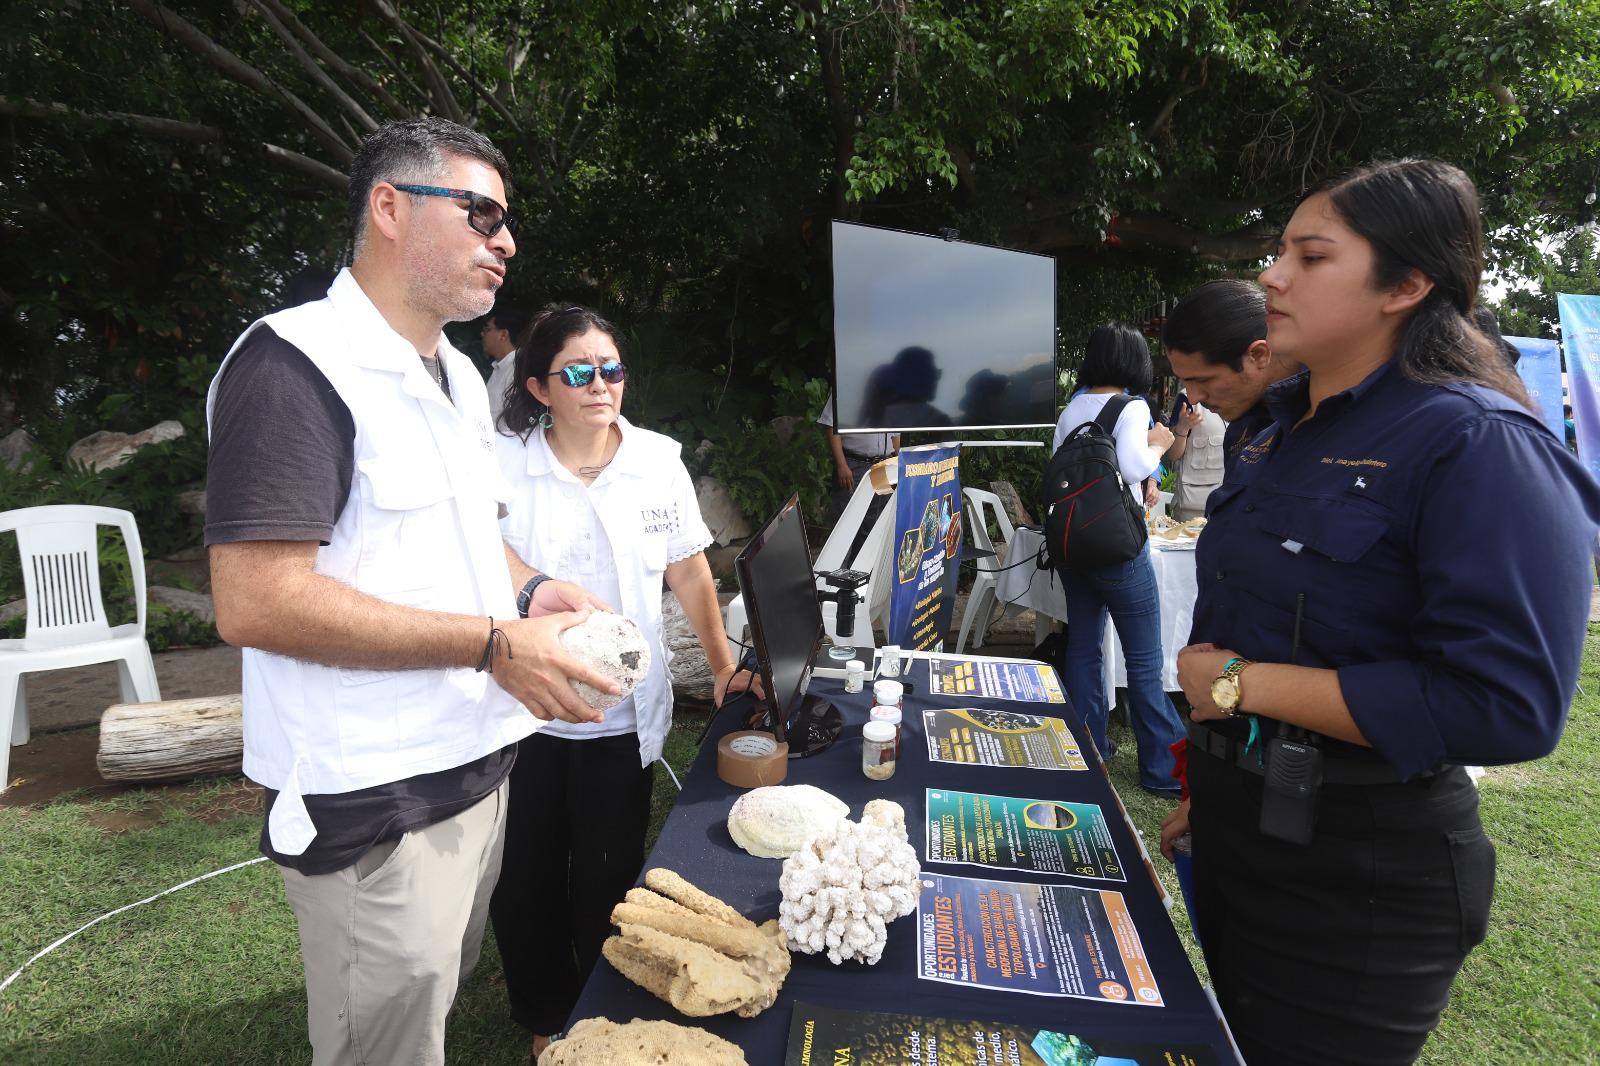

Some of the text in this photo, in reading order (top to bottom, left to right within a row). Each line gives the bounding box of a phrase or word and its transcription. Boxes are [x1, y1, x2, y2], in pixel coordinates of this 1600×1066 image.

[641, 509, 669, 522] UNA
[942, 814, 957, 857] ESTUDIANTES
[979, 901, 989, 910] DE
[923, 913, 938, 977] OPORTUNIDADES
[935, 895, 957, 973] ESTUDIANTES
[980, 910, 998, 968] CARACTERIZACIÓN
[995, 929, 1006, 938] DE
[908, 1031, 921, 1060] desde
[972, 1031, 985, 1043] de
[988, 1031, 1004, 1063] medio,
